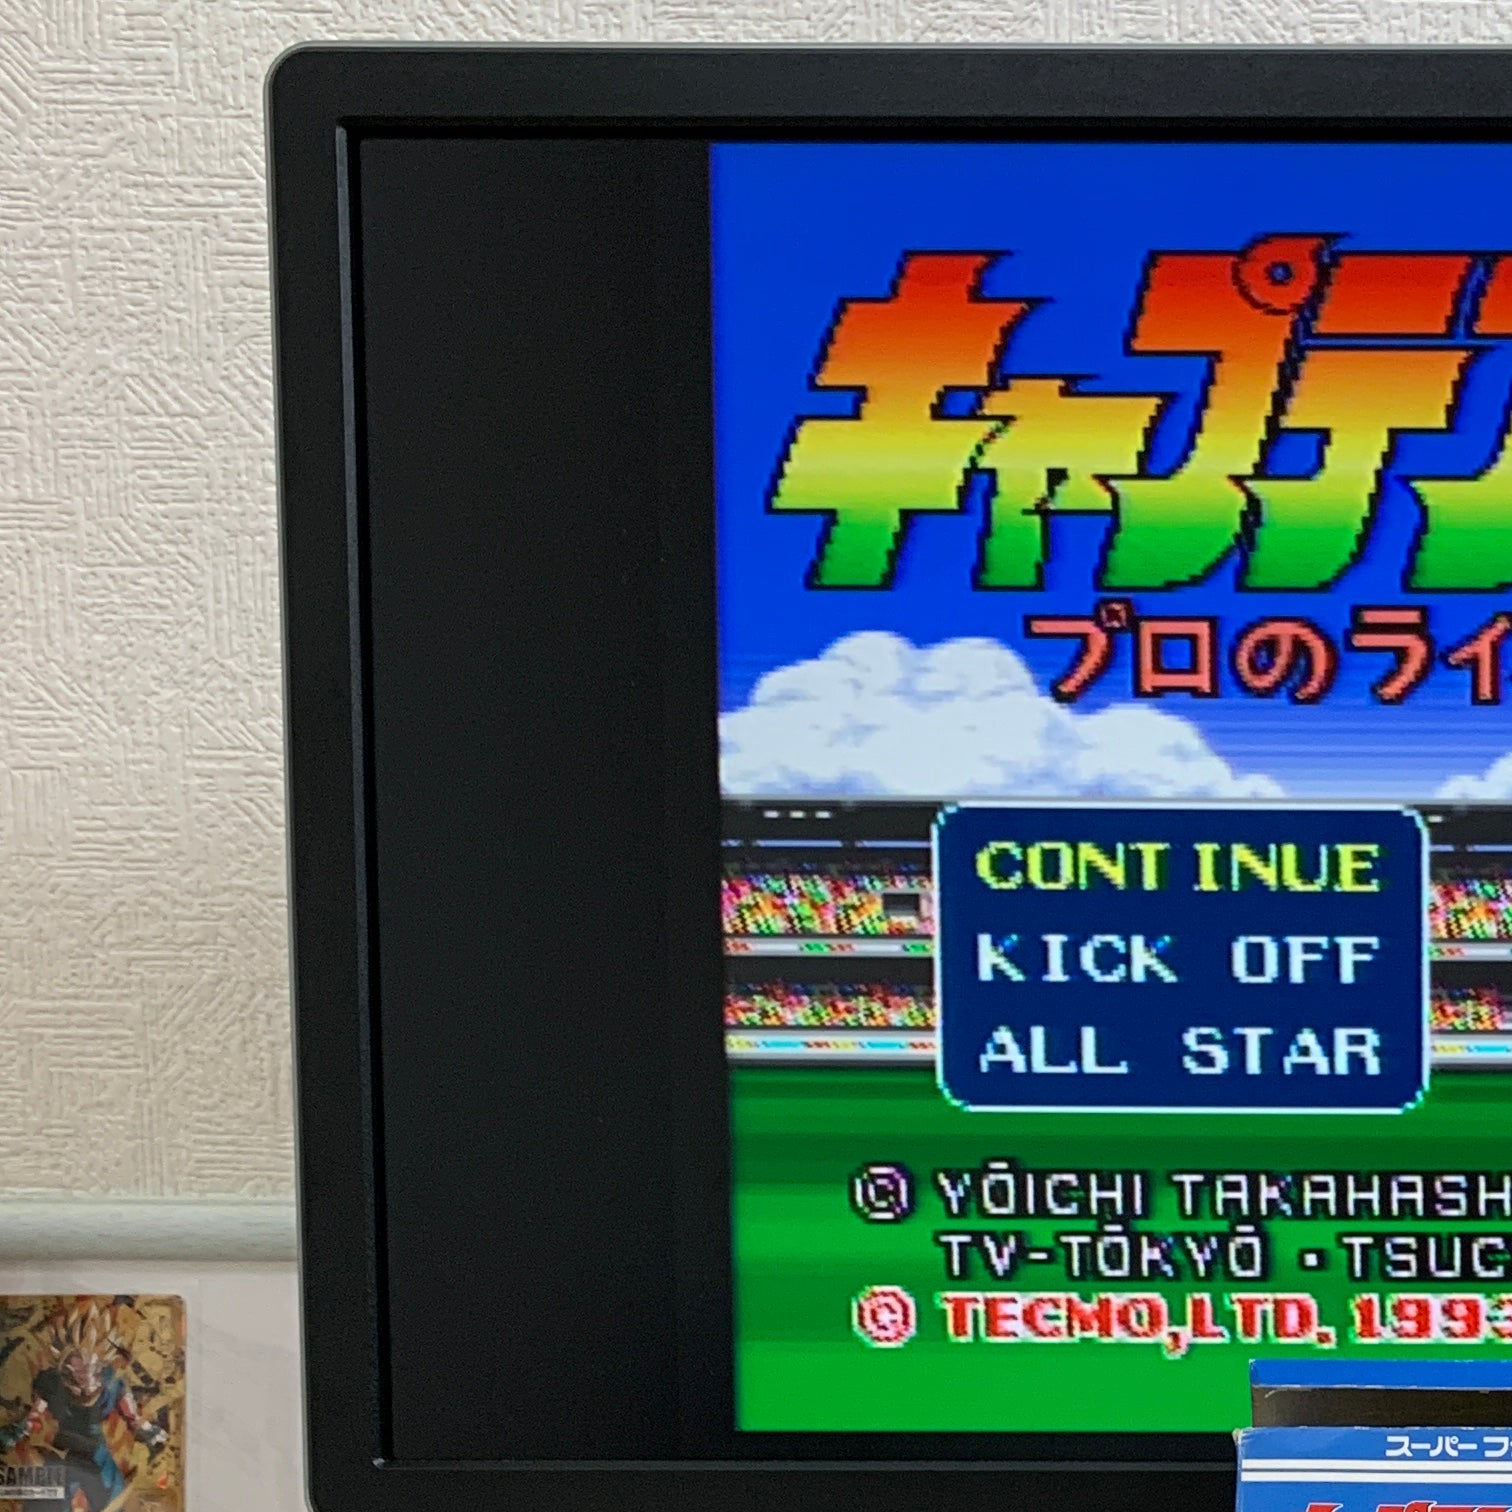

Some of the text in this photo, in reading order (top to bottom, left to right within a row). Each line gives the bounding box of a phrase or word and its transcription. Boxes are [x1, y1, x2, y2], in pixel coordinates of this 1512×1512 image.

[977, 933, 1380, 984] KICK OFF
[979, 1025, 1381, 1075] ALL STAR
